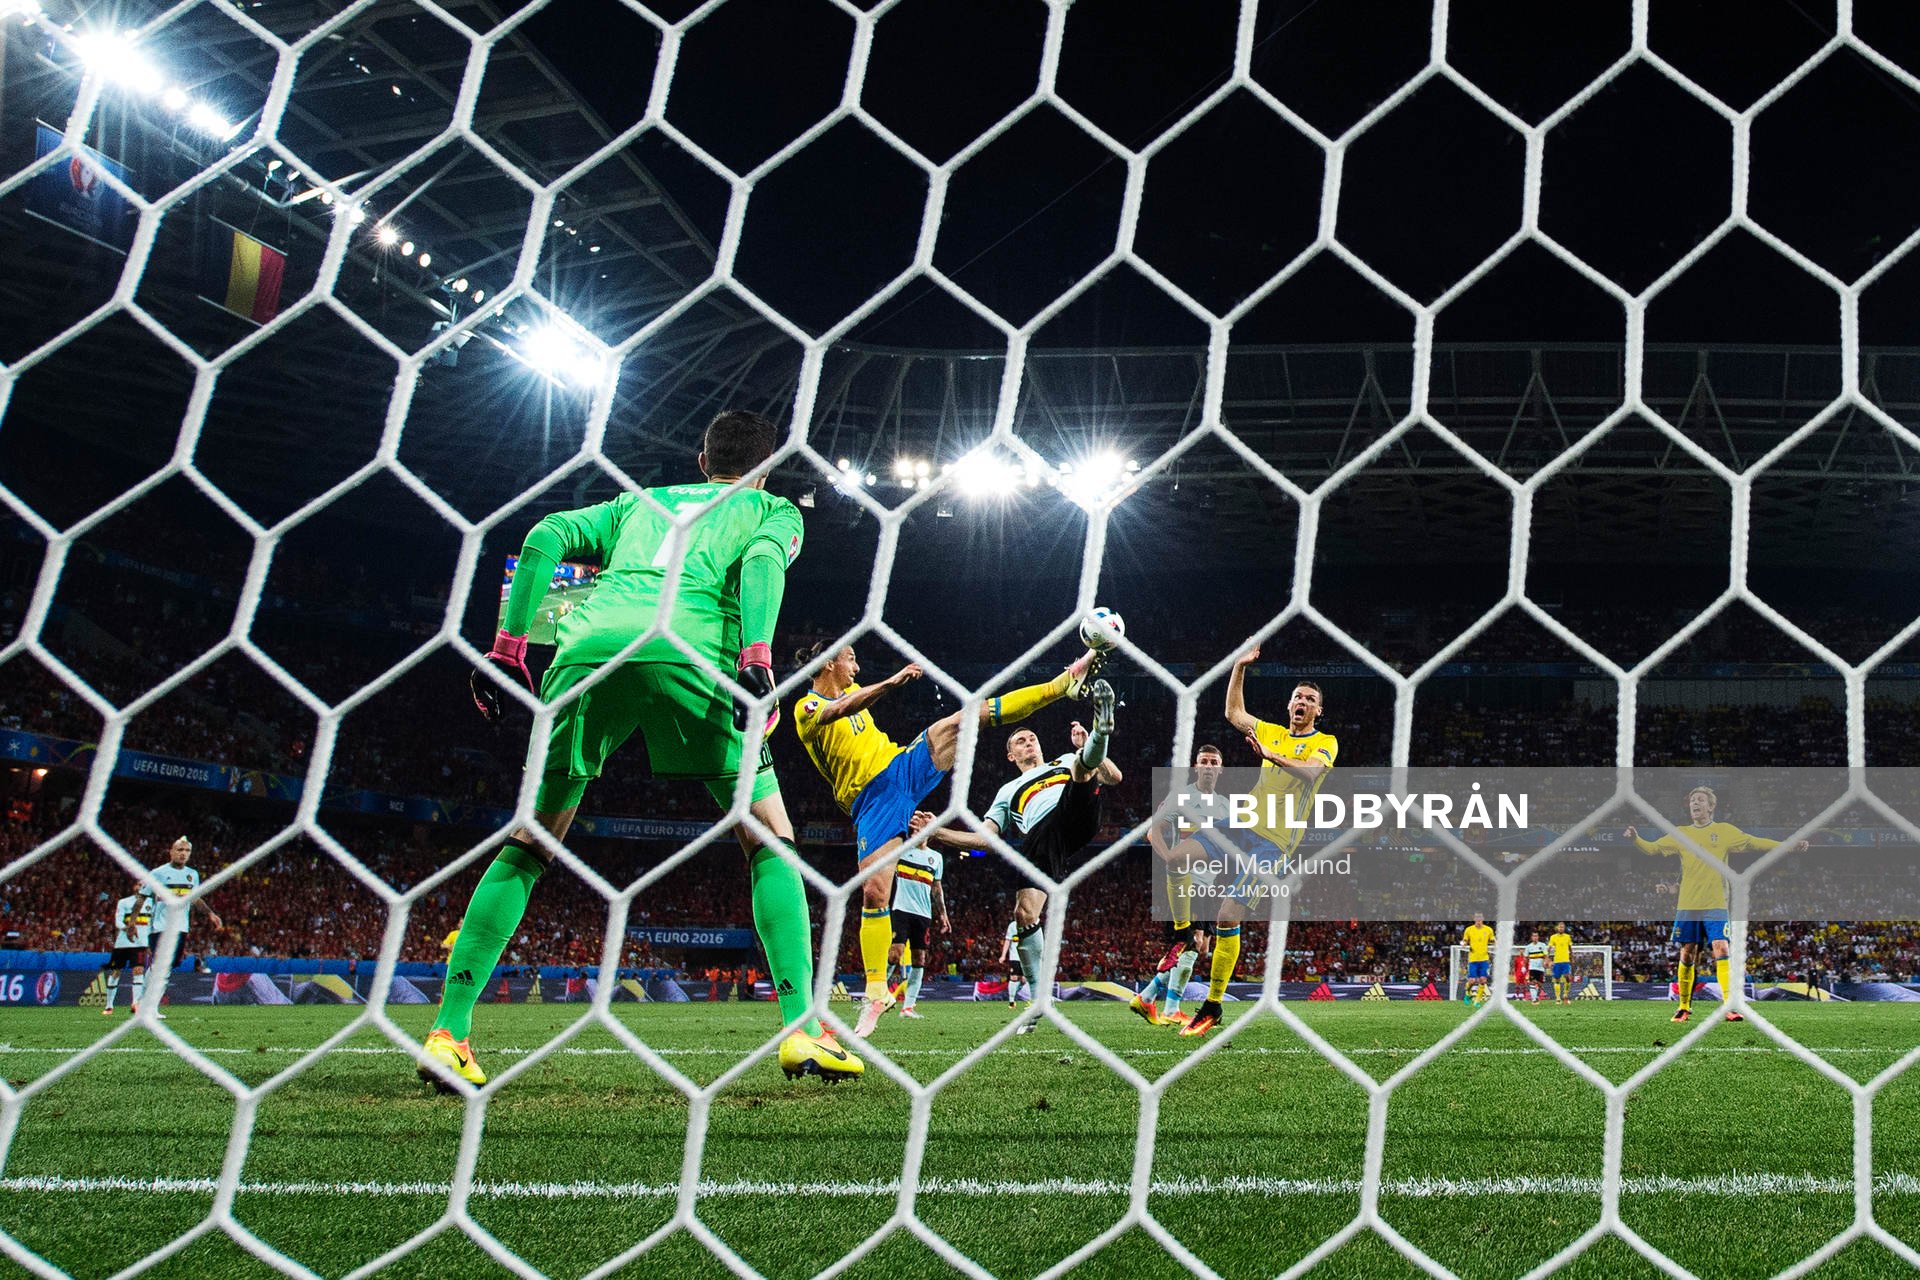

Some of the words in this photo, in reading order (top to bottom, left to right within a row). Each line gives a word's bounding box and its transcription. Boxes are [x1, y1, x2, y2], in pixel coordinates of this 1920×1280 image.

[848, 714, 866, 736] 10
[133, 759, 158, 774] UEFA
[160, 763, 185, 778] EURO
[187, 767, 209, 781] 2016
[613, 823, 641, 834] UEFA
[644, 824, 674, 836] EURO
[1309, 832, 1335, 842] 2016
[655, 932, 690, 944] EURO
[691, 933, 725, 945] 2016
[0, 974, 25, 1002] 16
[79, 995, 107, 1007] adida
